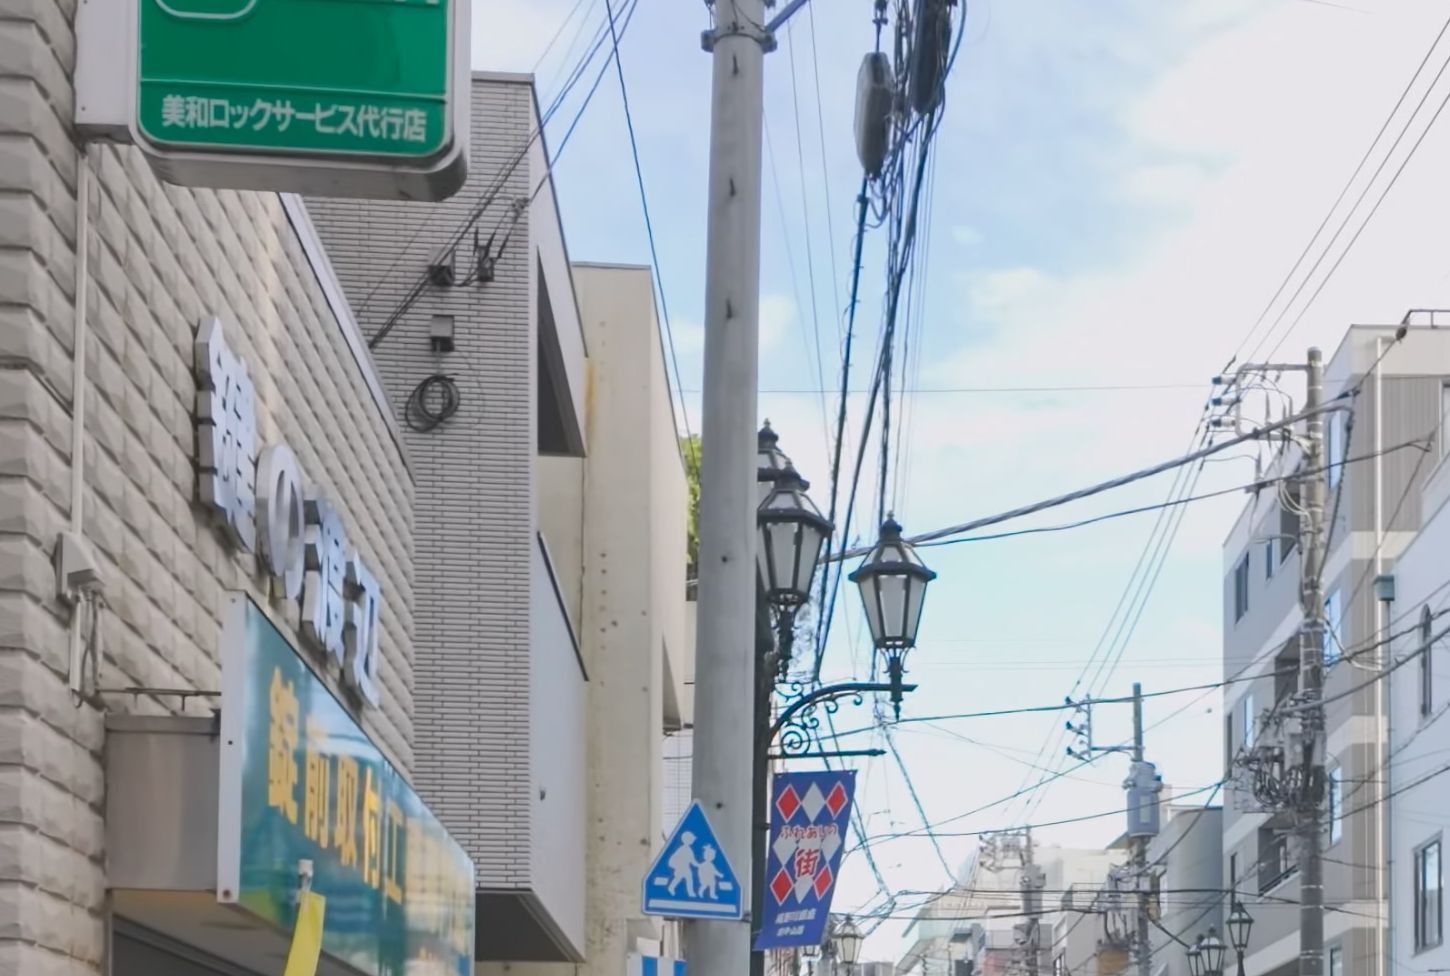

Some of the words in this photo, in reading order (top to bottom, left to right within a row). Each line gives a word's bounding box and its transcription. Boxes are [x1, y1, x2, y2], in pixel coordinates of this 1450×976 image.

[161, 94, 428, 142] 美和ロックサービス代行店
[780, 823, 839, 840] ふれあいの
[795, 848, 821, 878] 街
